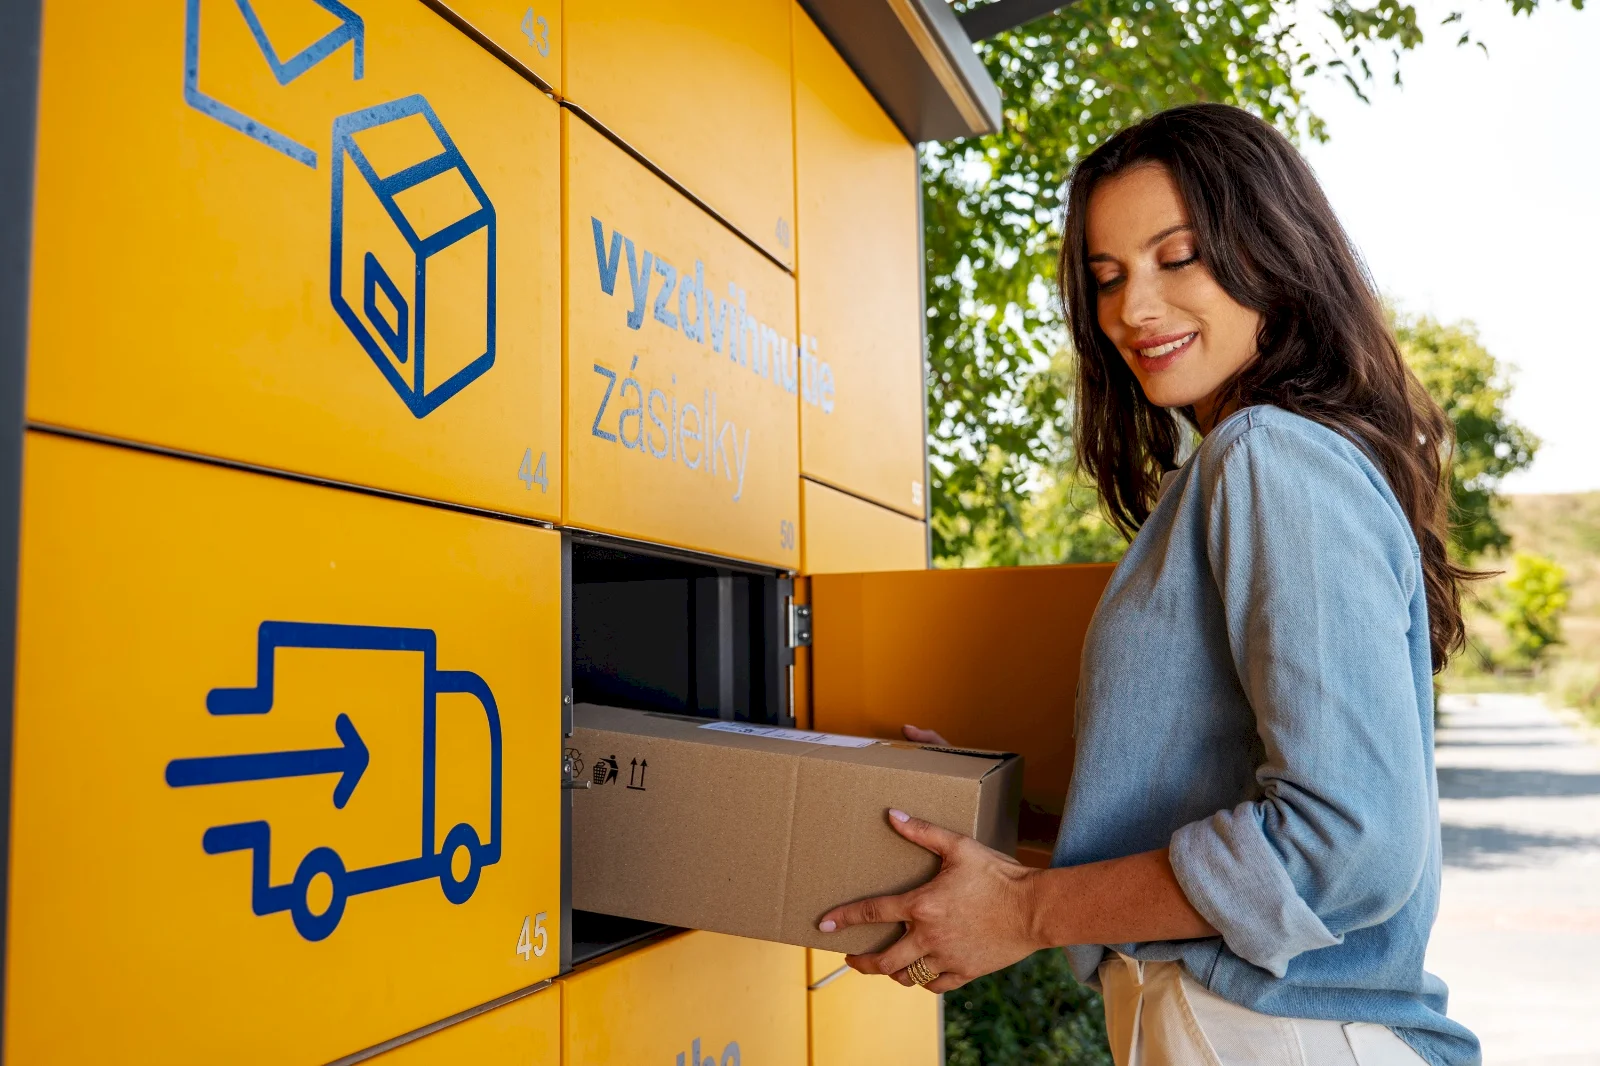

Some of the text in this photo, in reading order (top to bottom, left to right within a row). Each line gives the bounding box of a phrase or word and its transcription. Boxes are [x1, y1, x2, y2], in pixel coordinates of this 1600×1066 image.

[521, 6, 549, 58] 43
[591, 216, 835, 414] vyzdvihnutie
[591, 355, 750, 502] zásielky
[517, 447, 548, 493] 44
[780, 519, 794, 550] 50
[516, 911, 547, 960] 45
